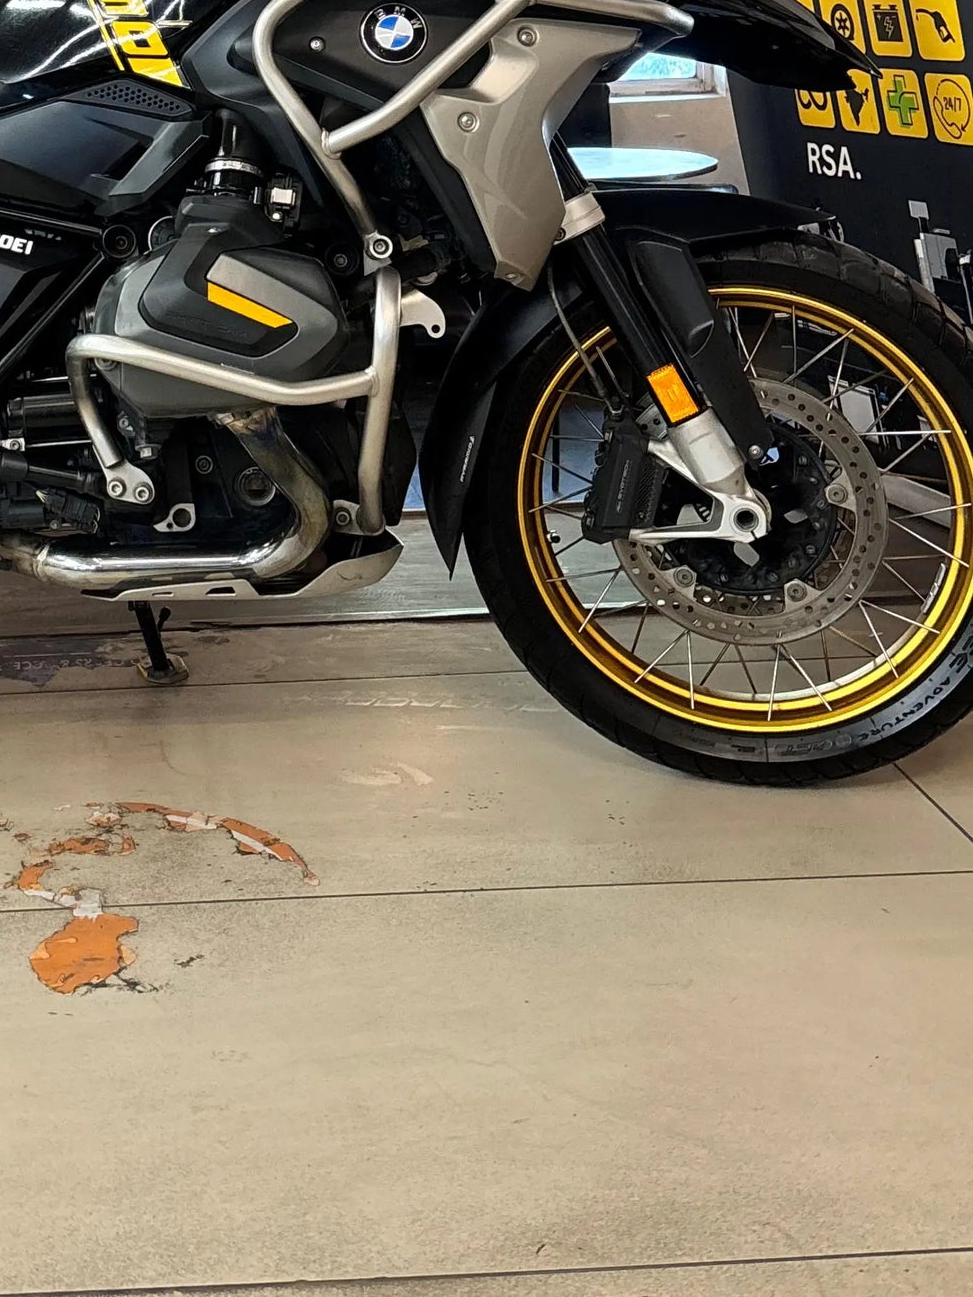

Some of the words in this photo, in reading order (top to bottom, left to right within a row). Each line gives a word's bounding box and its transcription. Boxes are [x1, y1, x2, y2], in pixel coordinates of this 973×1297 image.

[374, 5, 423, 29] BMW
[943, 96, 962, 113] 24/7
[807, 142, 862, 181] RSA.
